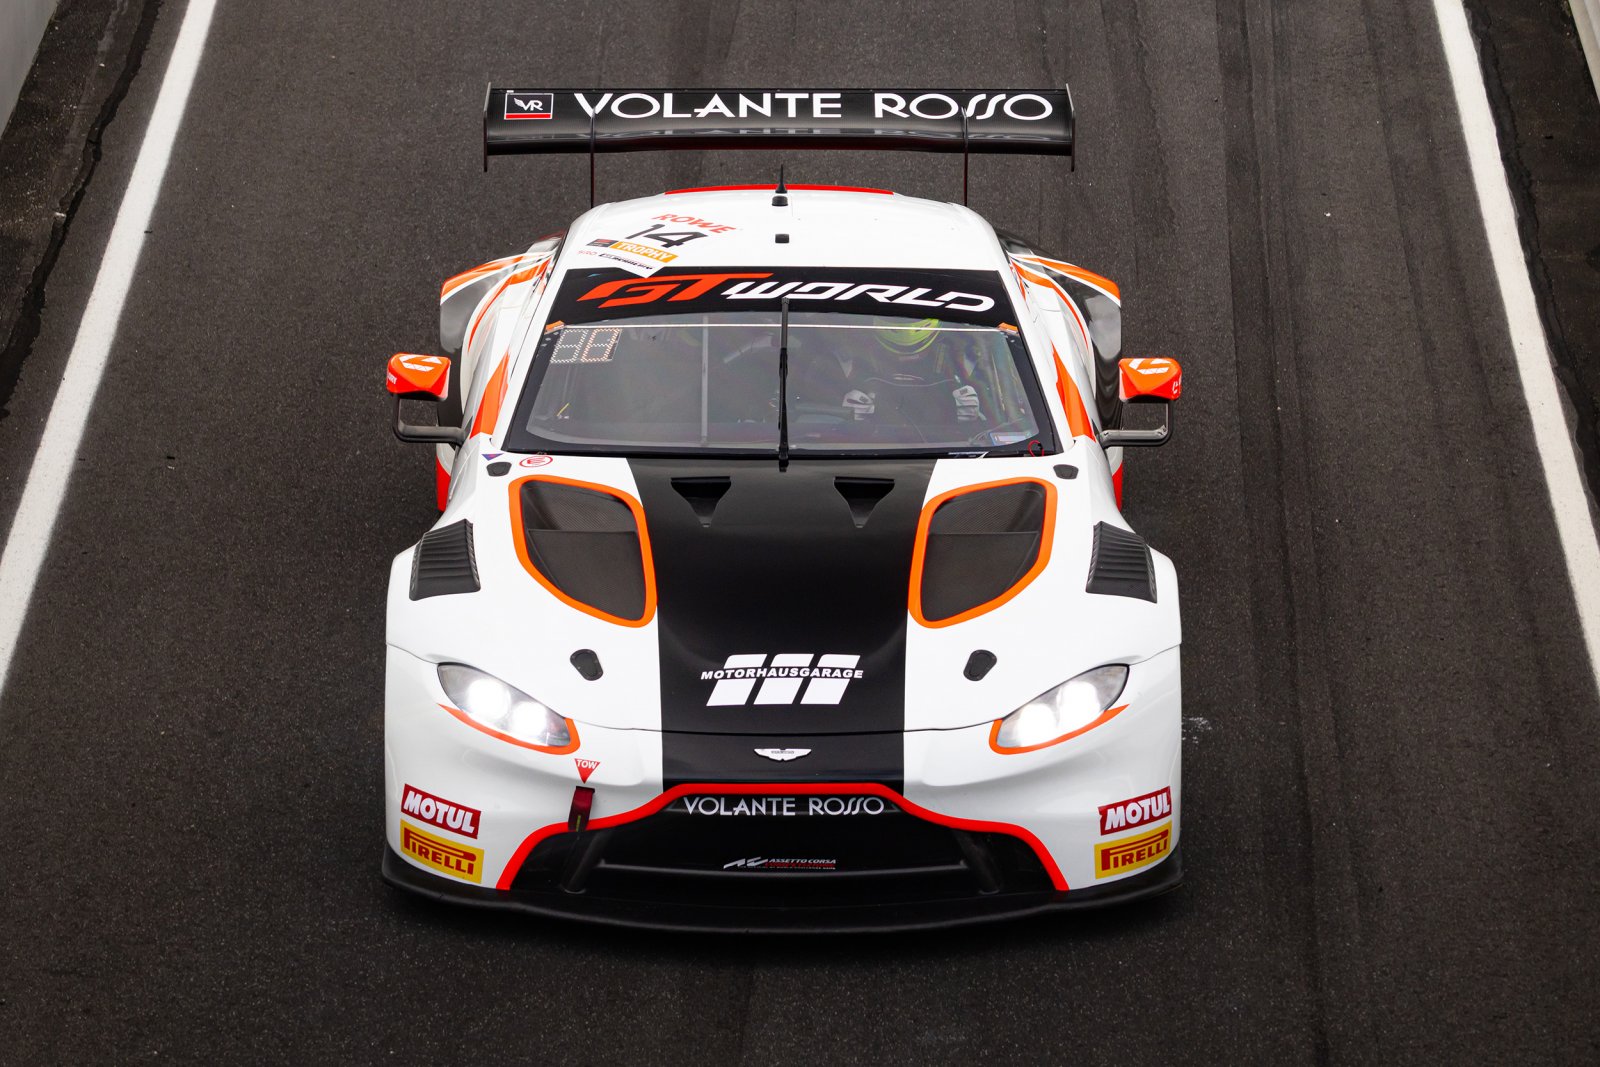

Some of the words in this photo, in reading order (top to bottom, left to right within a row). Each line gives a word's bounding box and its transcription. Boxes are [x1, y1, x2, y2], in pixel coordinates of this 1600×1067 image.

[573, 93, 842, 118] VOLANTE
[874, 93, 1053, 120] ROSSO
[625, 223, 709, 249] 14
[651, 214, 737, 234] ROWE
[615, 241, 671, 262] TROPHY
[576, 272, 774, 308] GT
[720, 281, 995, 312] WORLD
[701, 667, 864, 680] MOTORHAUSGARAGE
[577, 759, 598, 770] TOW
[403, 790, 475, 835] MOTUL
[683, 797, 796, 816] VOLANTE
[808, 797, 885, 815] ROSSO
[1104, 792, 1170, 831] MOTUL
[403, 827, 476, 876] PIRELLI
[1100, 829, 1169, 871] PIRELLI
